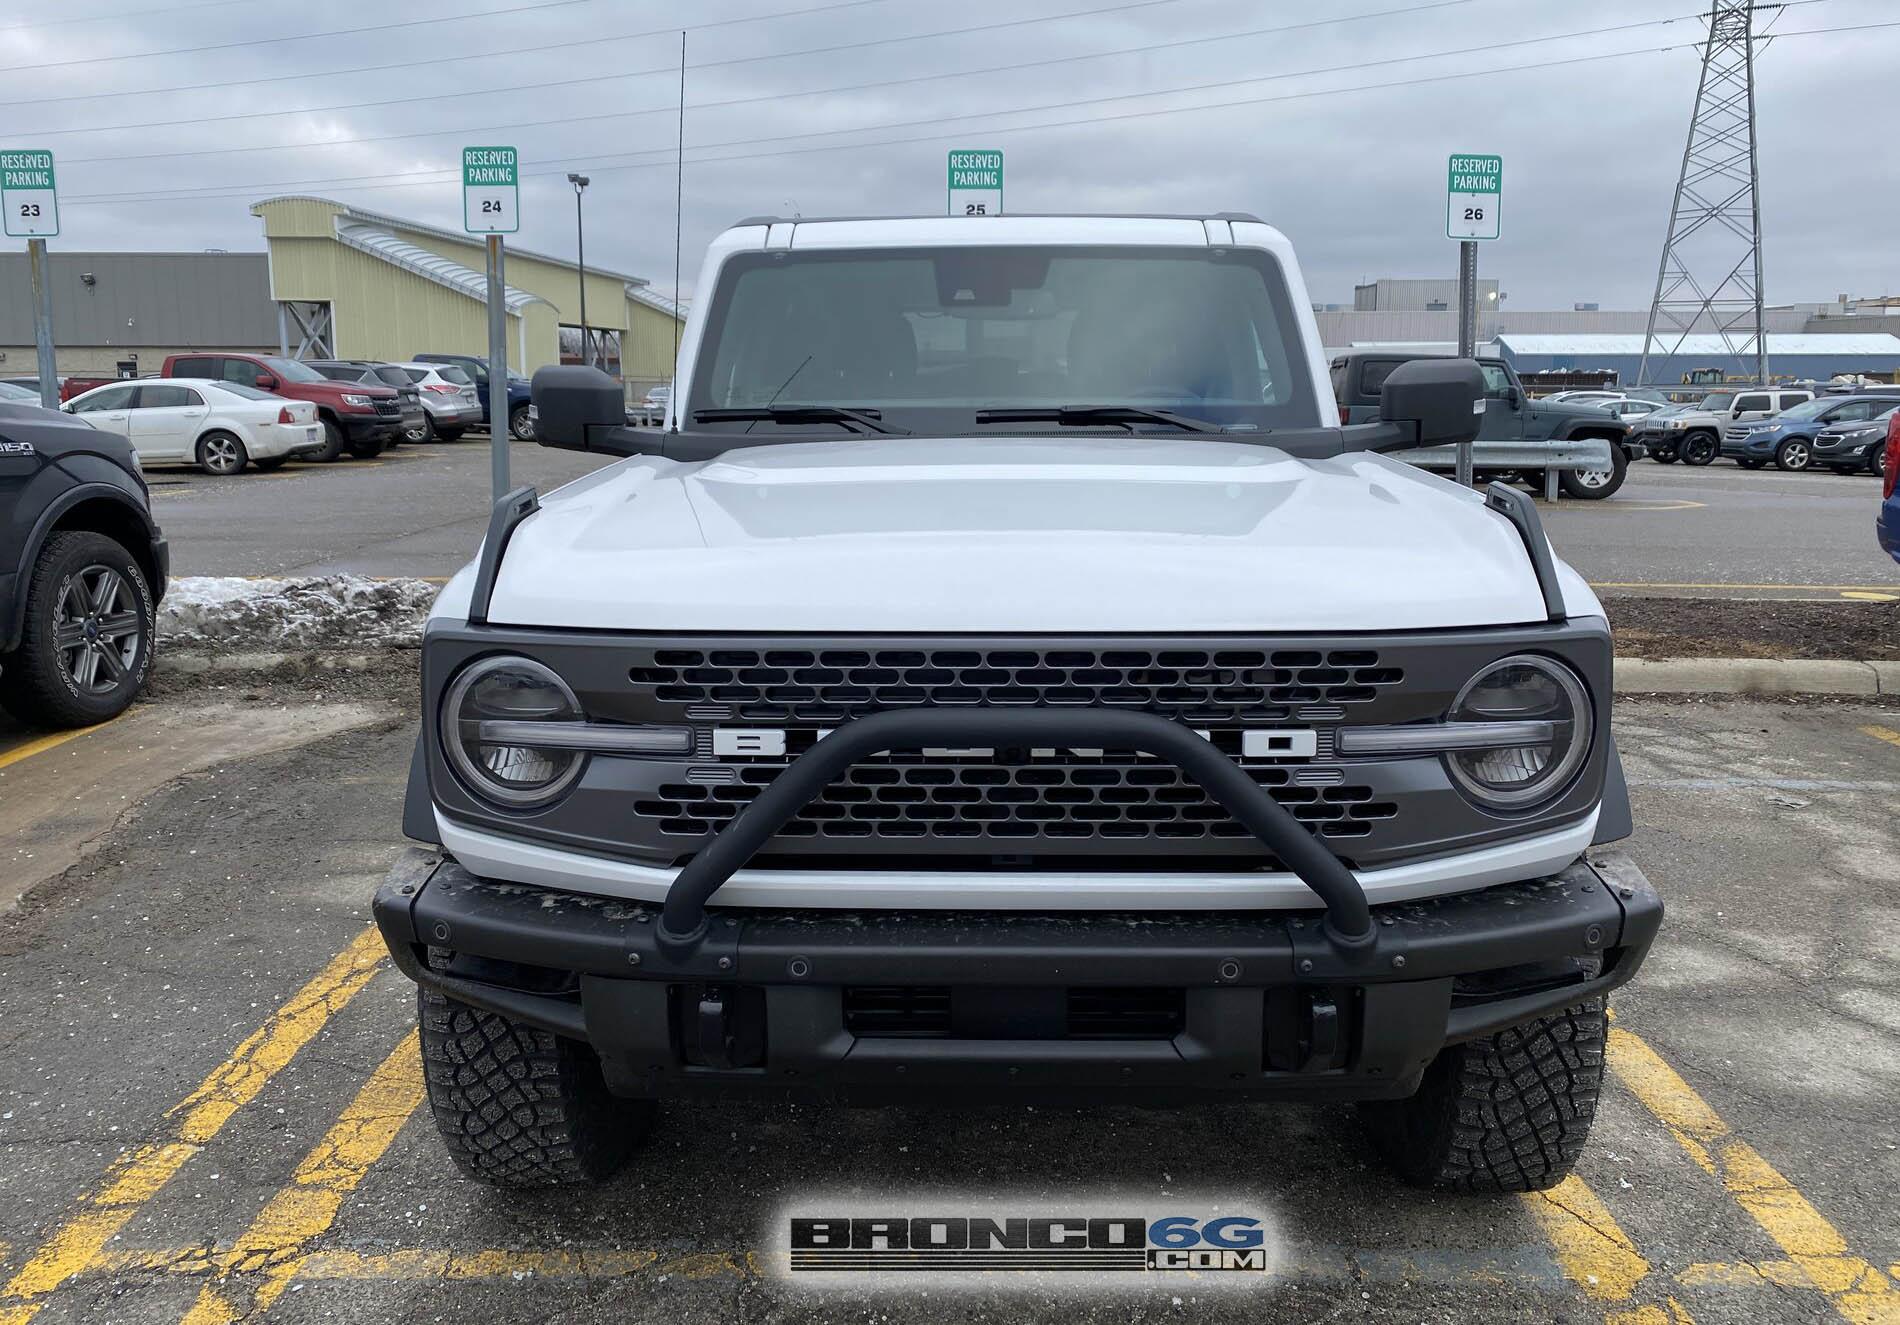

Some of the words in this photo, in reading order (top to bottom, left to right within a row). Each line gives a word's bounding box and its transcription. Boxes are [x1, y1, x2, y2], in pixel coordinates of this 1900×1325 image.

[1, 154, 50, 169] RESERVED
[465, 151, 514, 165] RESERVED
[951, 154, 1000, 169] RESERVED
[1451, 159, 1499, 173] RESERVED
[5, 171, 49, 186] PARKING
[469, 168, 512, 182] PARKING
[954, 171, 998, 186] PARKING
[1454, 175, 1496, 190] PARKING
[20, 204, 41, 217] 23
[481, 200, 502, 213] 24
[966, 204, 986, 215] 25
[1464, 208, 1484, 221] 26
